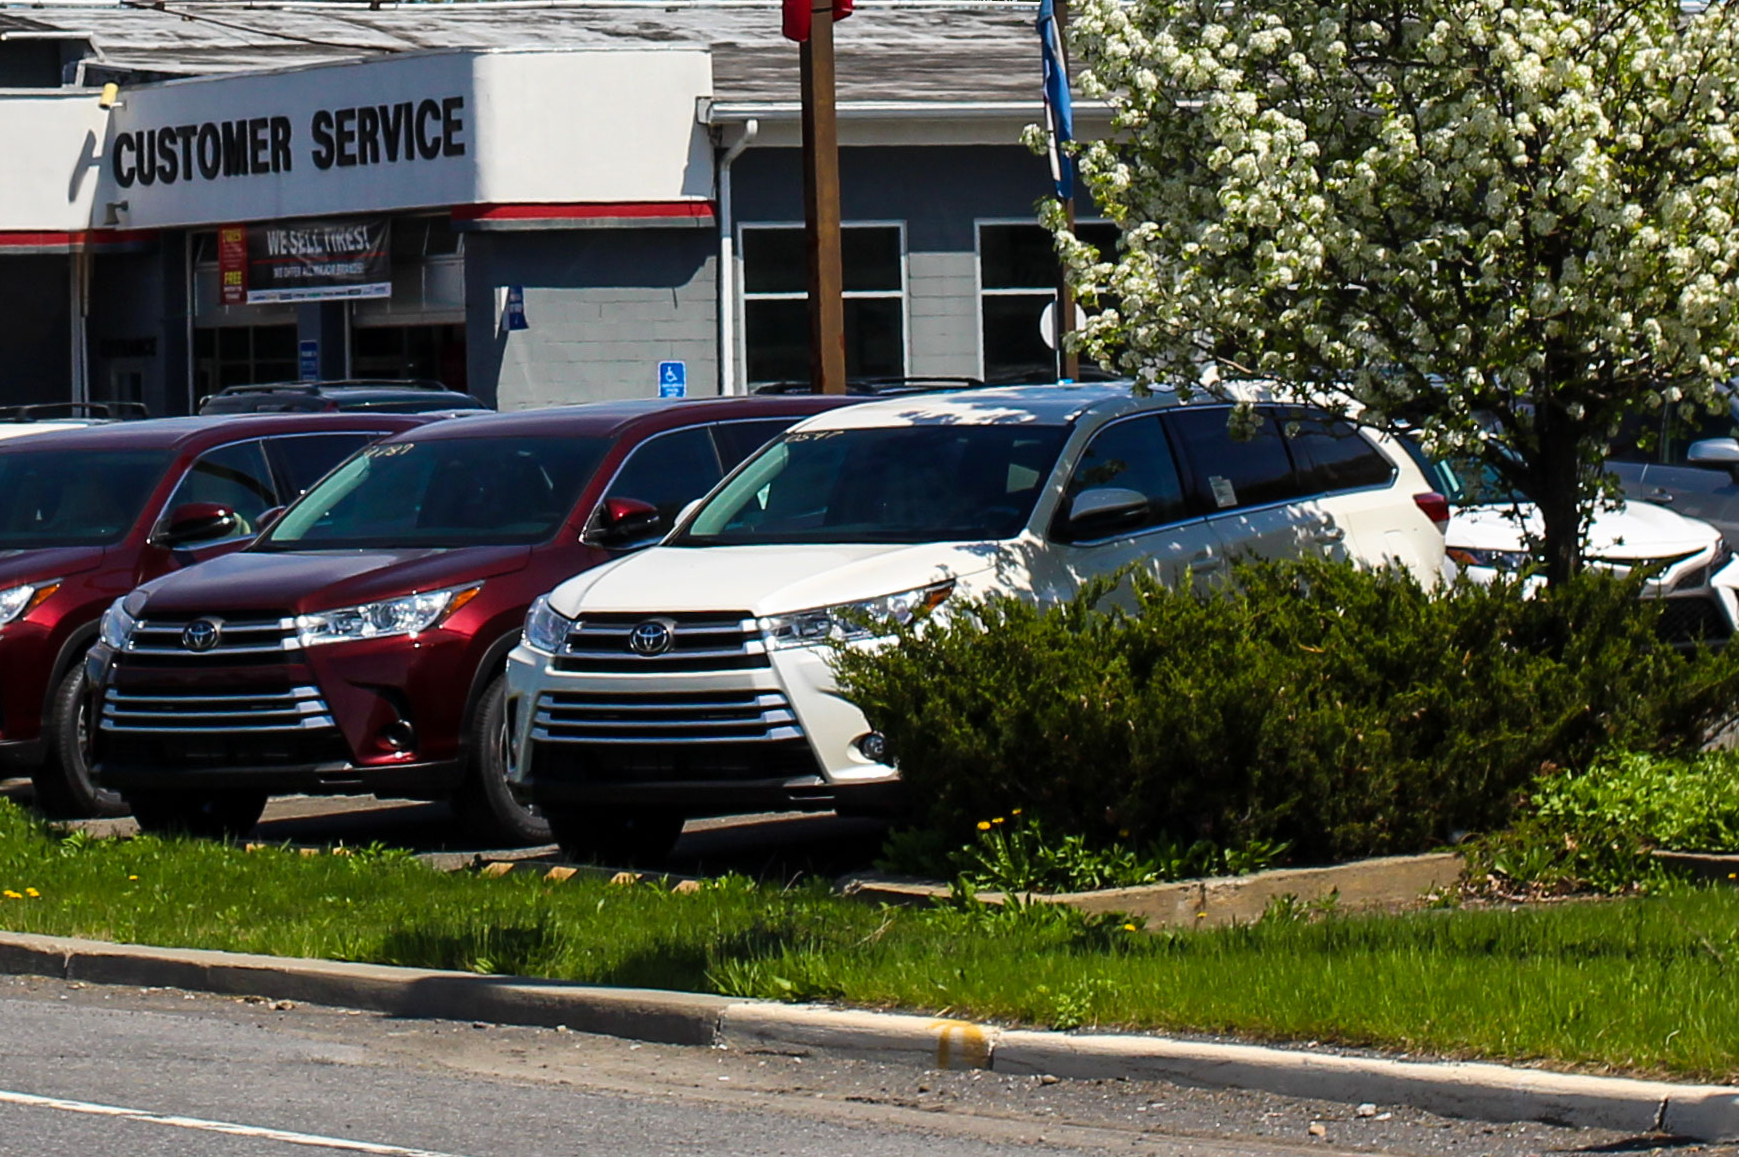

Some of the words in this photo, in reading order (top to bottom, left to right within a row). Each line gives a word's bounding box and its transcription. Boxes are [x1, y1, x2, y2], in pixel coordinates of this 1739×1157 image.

[112, 115, 292, 189] CUSTOMER
[312, 96, 465, 170] SERVICE
[267, 229, 288, 256] WE
[289, 228, 322, 254] SELL
[323, 226, 370, 252] TIRES!
[224, 271, 242, 285] FREE
